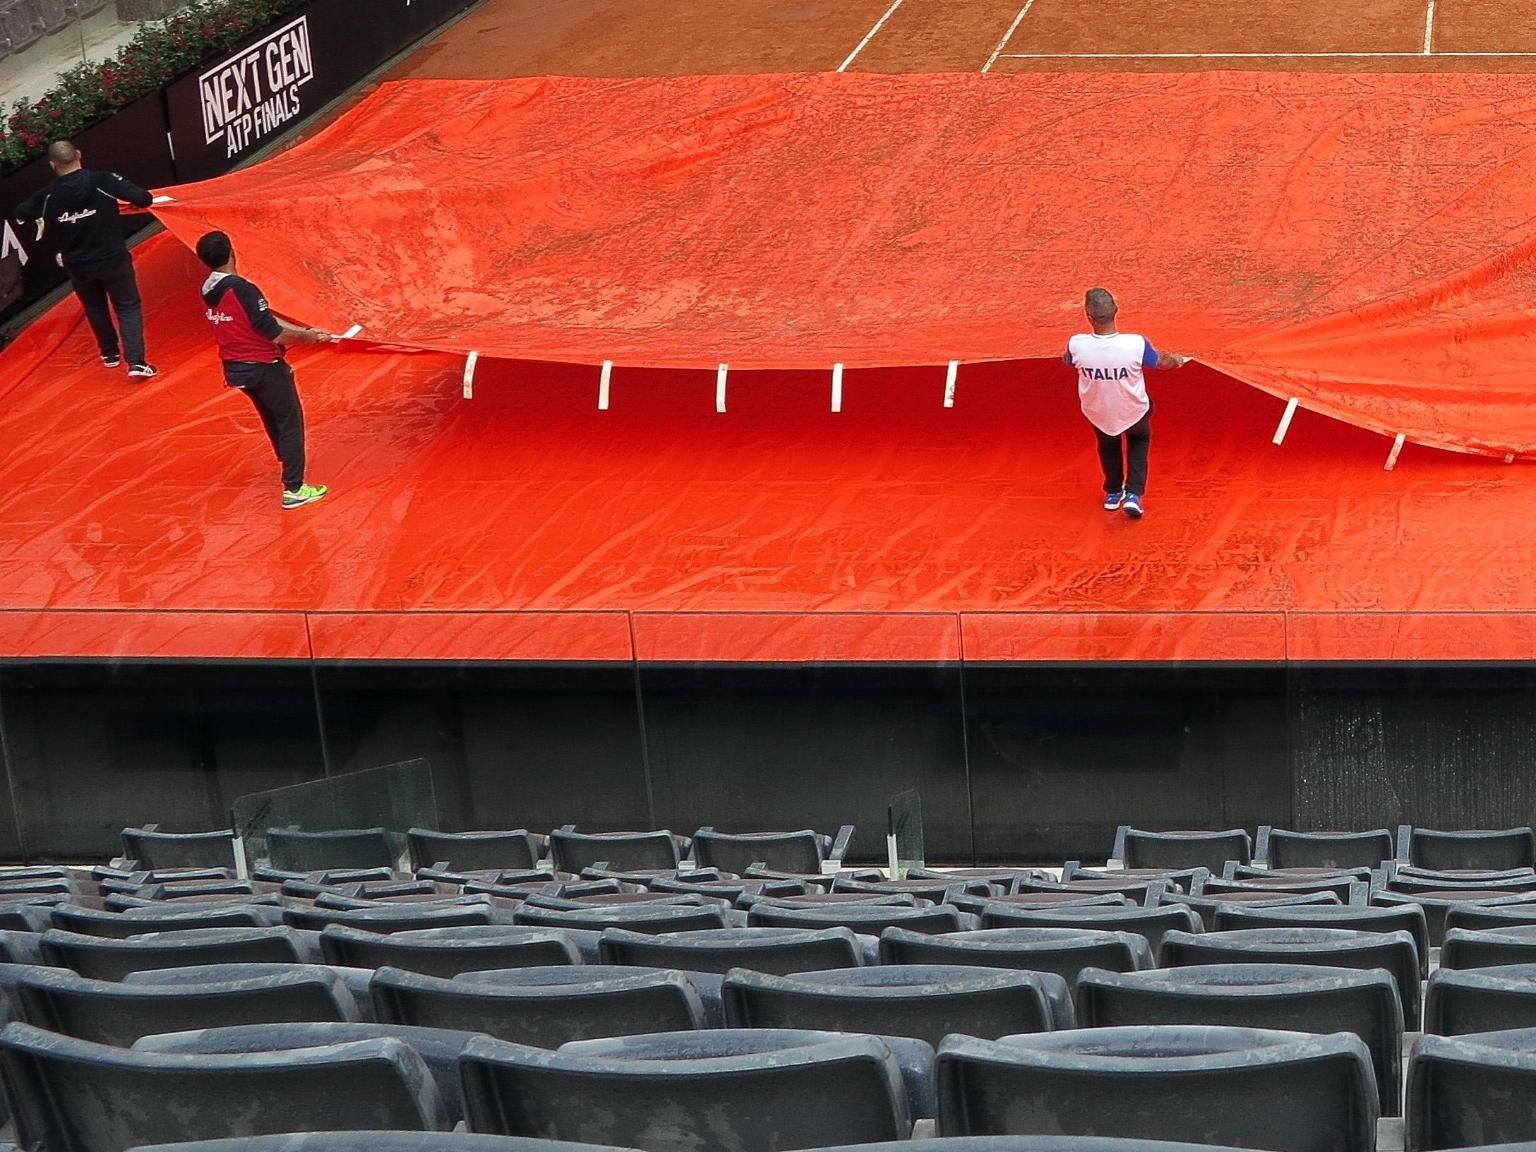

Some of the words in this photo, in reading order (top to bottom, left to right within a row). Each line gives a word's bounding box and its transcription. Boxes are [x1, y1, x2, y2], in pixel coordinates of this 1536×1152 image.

[204, 50, 261, 134] NEXT
[265, 24, 310, 93] GEN
[227, 113, 252, 159] ATP
[253, 83, 300, 139] FINALS
[1081, 367, 1129, 381] ITALIA
